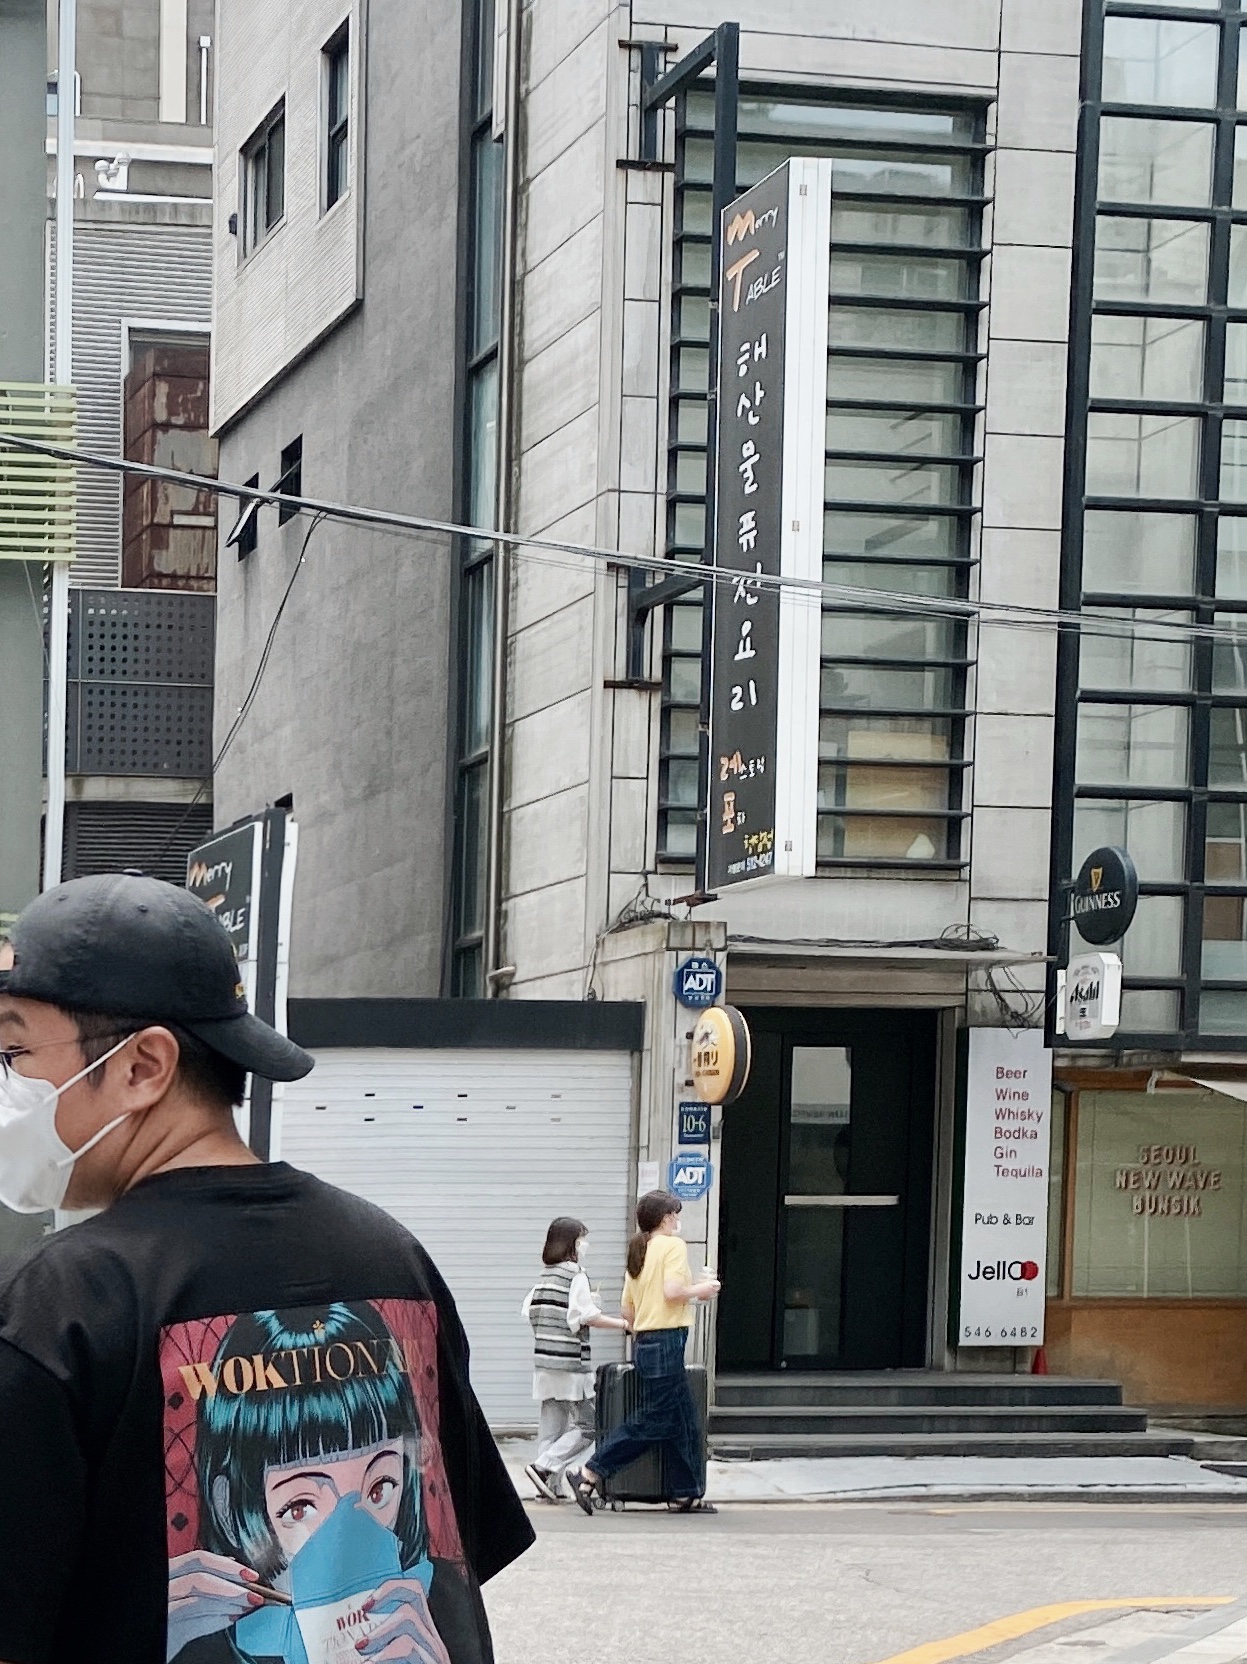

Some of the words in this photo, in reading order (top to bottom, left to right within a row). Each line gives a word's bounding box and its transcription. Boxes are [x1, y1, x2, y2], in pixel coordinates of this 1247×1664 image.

[726, 248, 782, 313] TABLE
[190, 861, 233, 891] Merry
[1075, 891, 1121, 914] GUINNESS
[684, 973, 715, 992] ADT
[995, 1066, 1028, 1079] Beer
[995, 1088, 1029, 1101] Wine
[682, 1114, 707, 1133] 10-6
[994, 1107, 1044, 1123] Whisky
[993, 1126, 1038, 1140] Bodka
[993, 1146, 1018, 1159] Gin
[1140, 1145, 1200, 1165] SEOUL
[673, 1166, 707, 1185] ADT
[993, 1164, 1043, 1179] Tequila
[1116, 1169, 1161, 1190] NEW
[1167, 1169, 1222, 1190] WAVE
[974, 1212, 999, 1225] Pub
[1002, 1212, 1012, 1226] &
[1015, 1213, 1035, 1226] Bar
